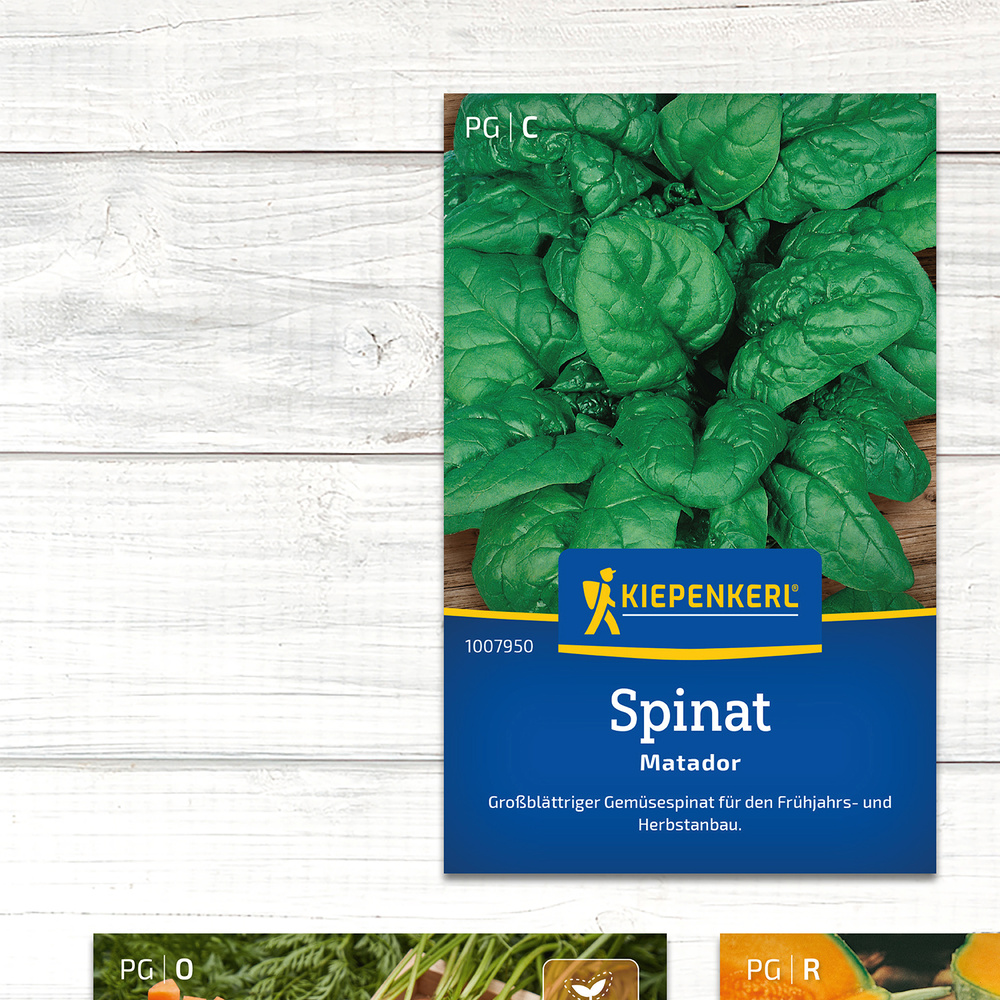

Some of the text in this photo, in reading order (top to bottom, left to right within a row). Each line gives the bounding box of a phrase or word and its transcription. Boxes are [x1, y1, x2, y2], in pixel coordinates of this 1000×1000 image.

[465, 115, 539, 139] PG C
[465, 639, 534, 654] 1007950
[610, 687, 772, 745] Spinat
[640, 753, 742, 772] Matador
[488, 794, 892, 813] Großblättriger Gemüsespinat für den Frühjahrs- und
[638, 817, 742, 831] Herbstanbau.
[120, 957, 194, 981] PG O
[747, 958, 821, 981] PG R
